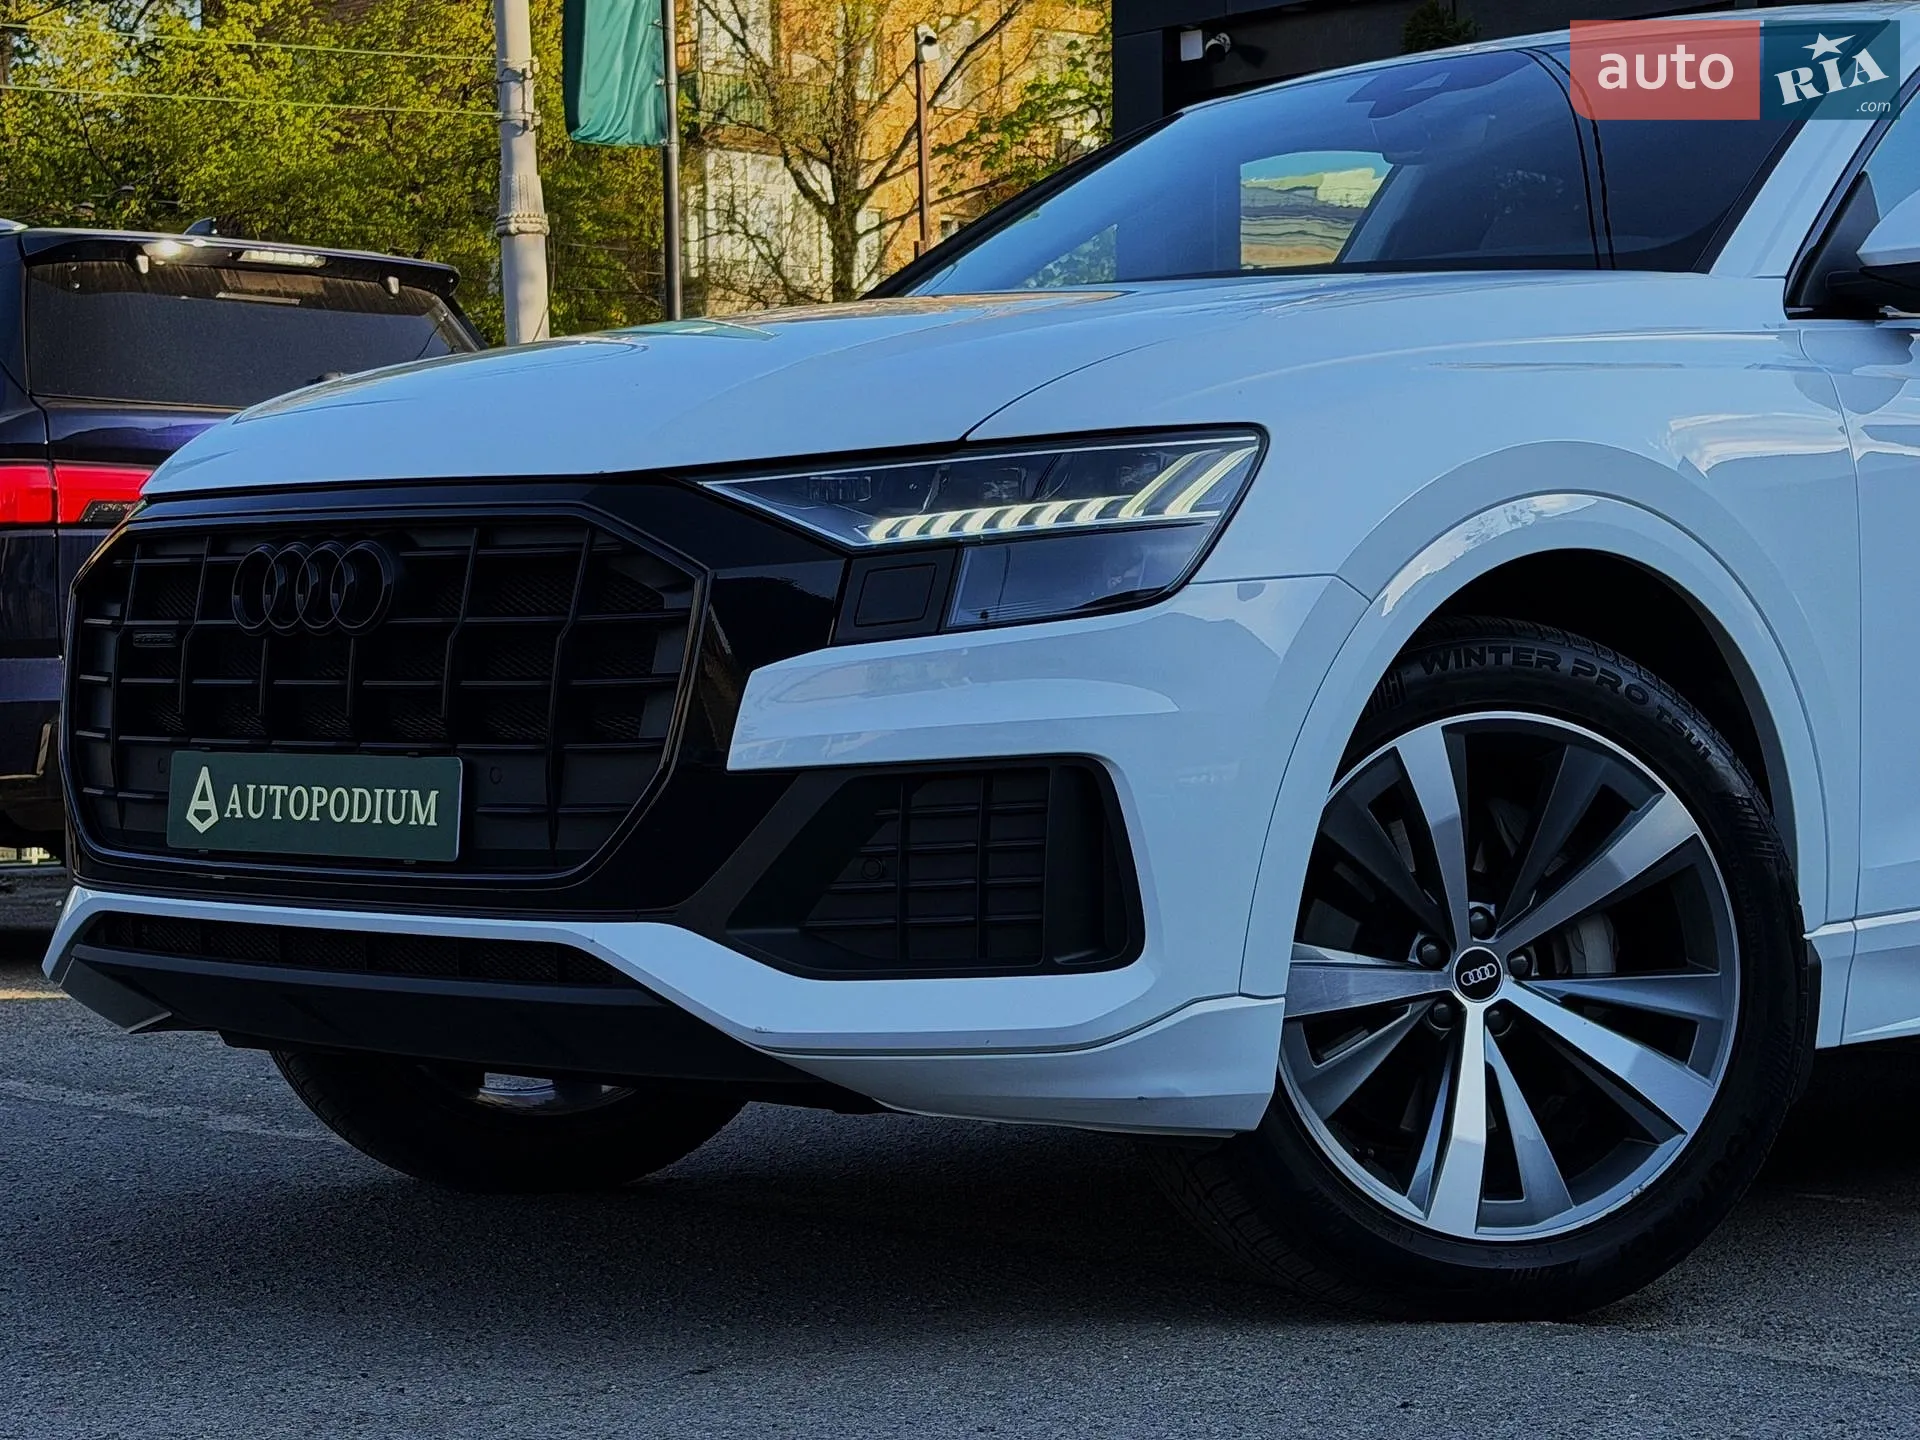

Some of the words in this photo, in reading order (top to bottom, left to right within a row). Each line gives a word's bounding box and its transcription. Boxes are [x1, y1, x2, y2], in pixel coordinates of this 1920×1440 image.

[1420, 645, 1562, 676] WINTER
[1570, 660, 1650, 707] PRO
[223, 783, 439, 827] AUTOPODIUM
